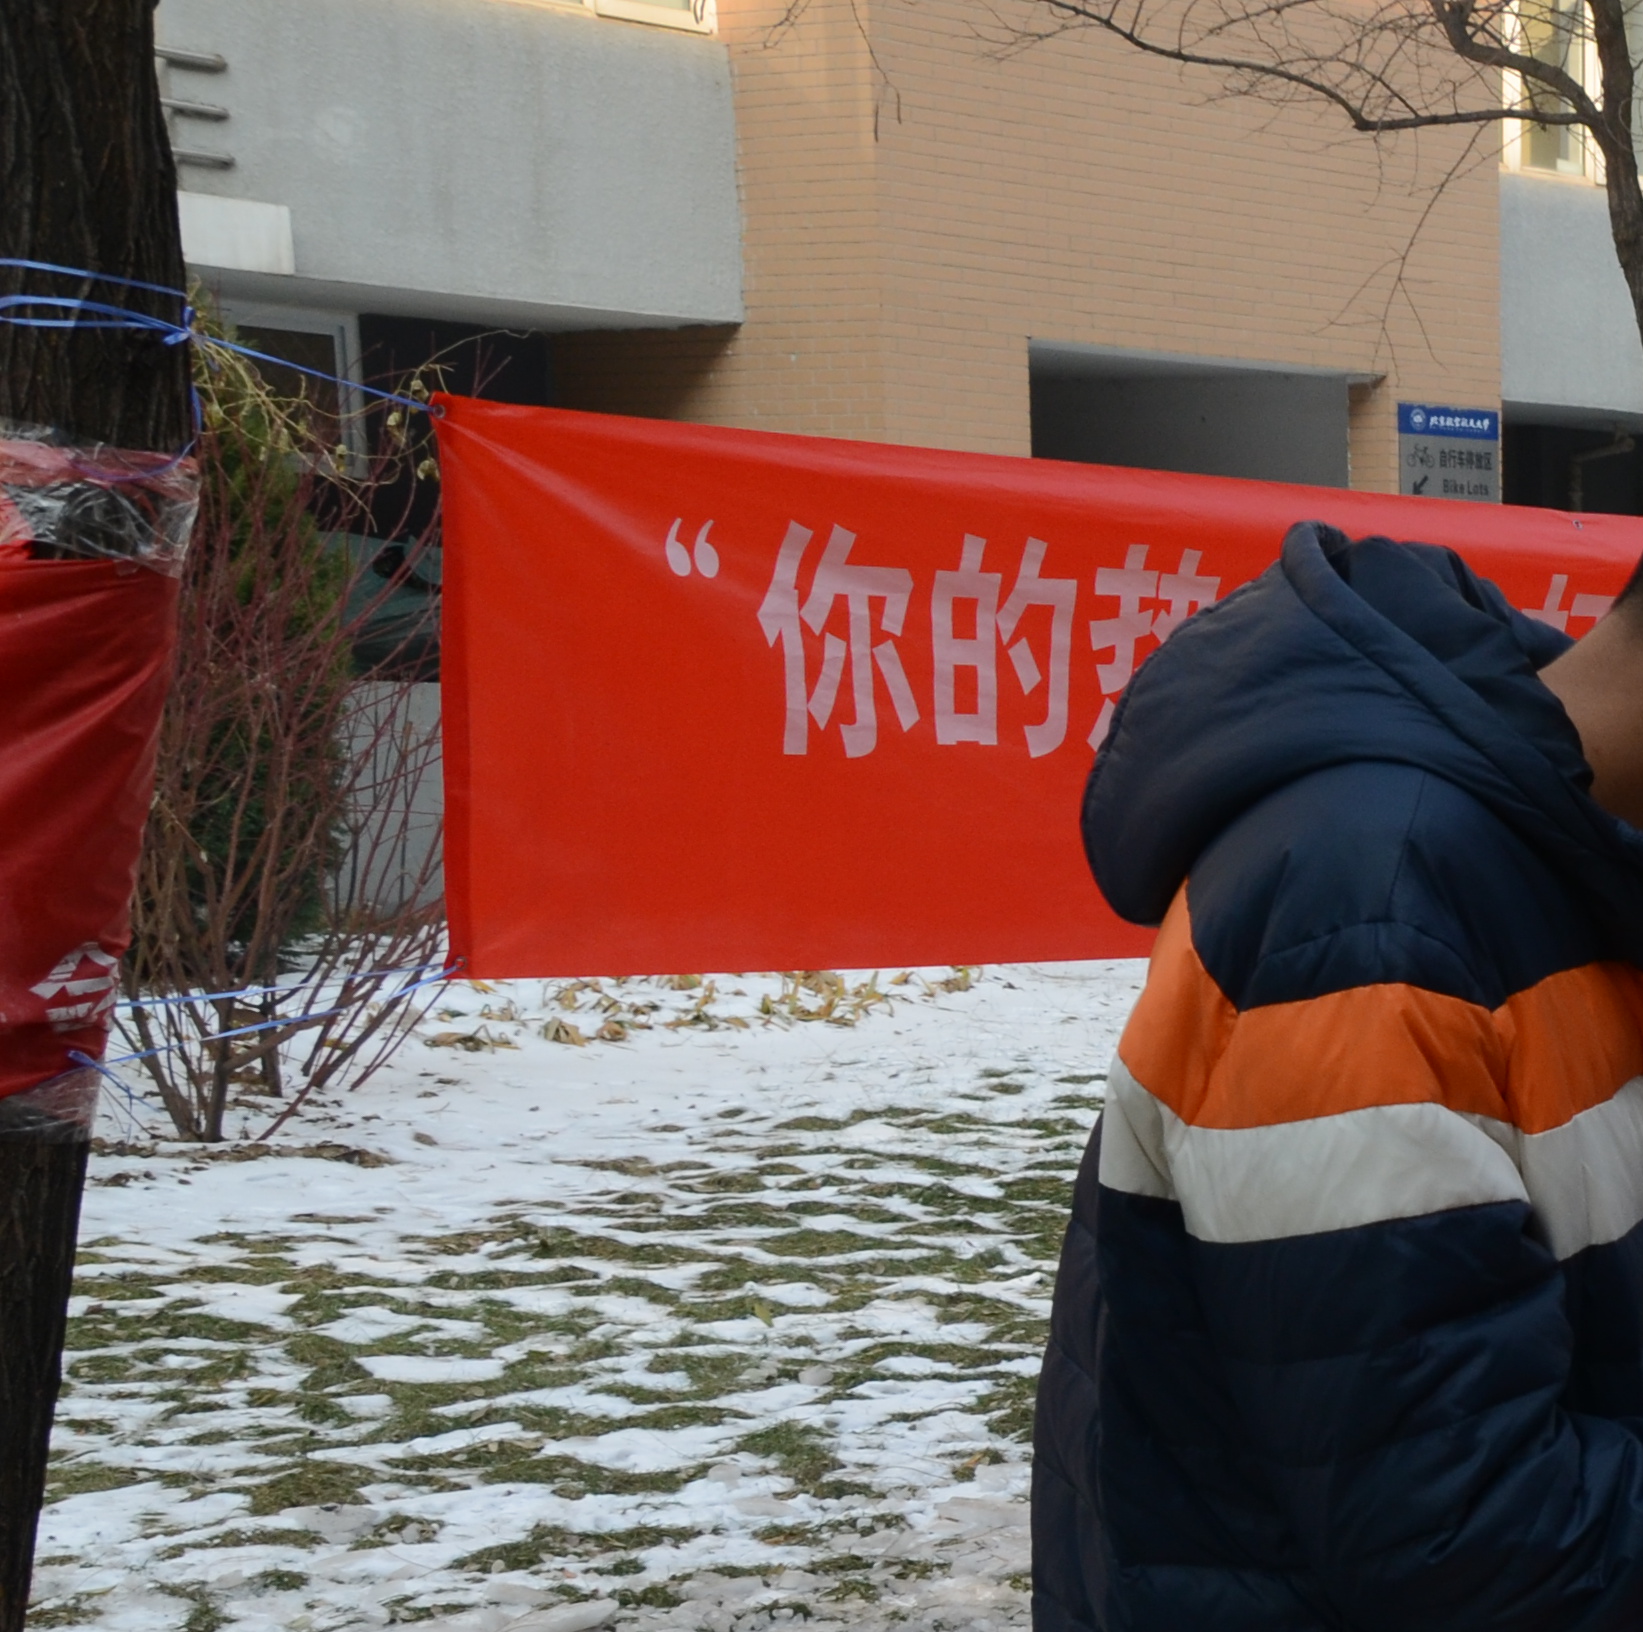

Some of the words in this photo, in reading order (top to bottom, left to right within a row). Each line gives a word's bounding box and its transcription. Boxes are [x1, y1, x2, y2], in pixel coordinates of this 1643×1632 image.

[1439, 449, 1493, 470] 自行车停放区
[1443, 478, 1465, 495] Bike
[1467, 480, 1489, 496] Lots
